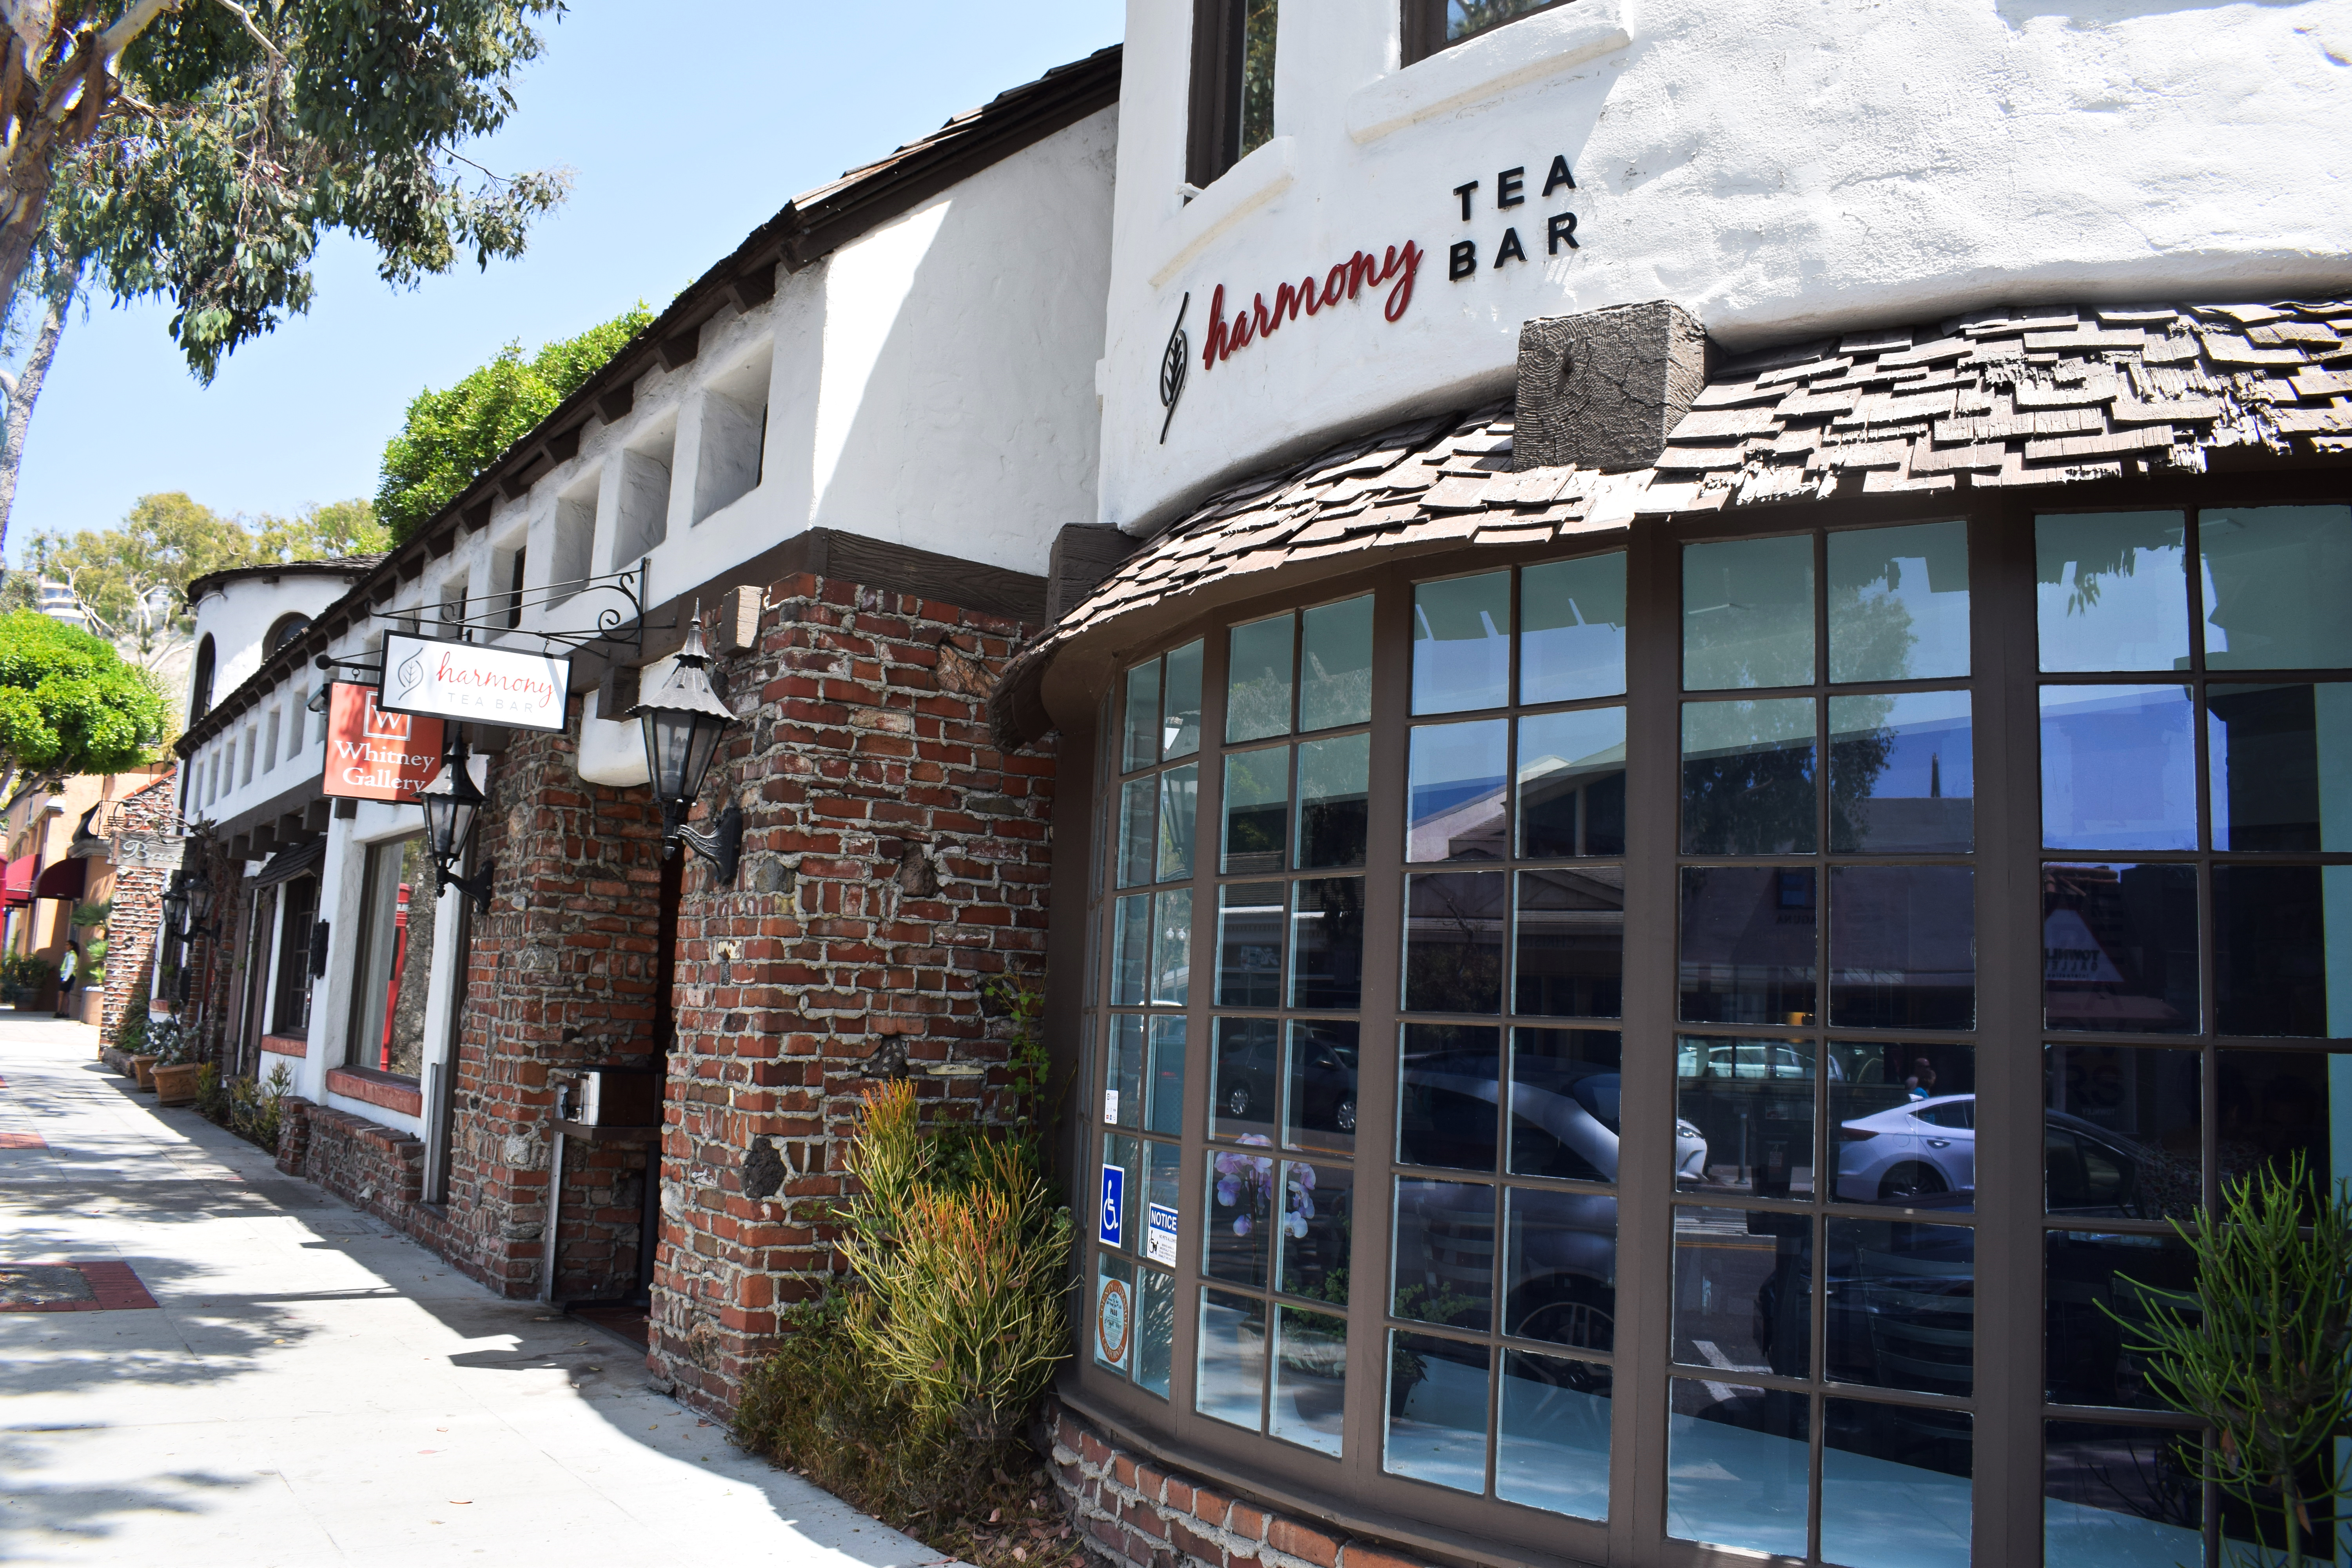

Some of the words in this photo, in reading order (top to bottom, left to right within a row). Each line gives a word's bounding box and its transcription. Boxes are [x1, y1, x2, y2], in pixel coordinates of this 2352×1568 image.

[1453, 154, 1577, 222] TEA
[1449, 212, 1580, 282] BAR
[1202, 240, 1424, 370] harmony
[436, 651, 556, 708] harmony
[448, 692, 484, 707] TEA
[496, 699, 533, 713] BAR
[334, 740, 436, 773] Whitney
[343, 767, 426, 792] Gallery
[1151, 1210, 1176, 1231] NOTICE
[1099, 1282, 1113, 1318] COUNTY
[1118, 1285, 1128, 1328] ORANGE
[1102, 1337, 1123, 1359] CALIFORNIA
